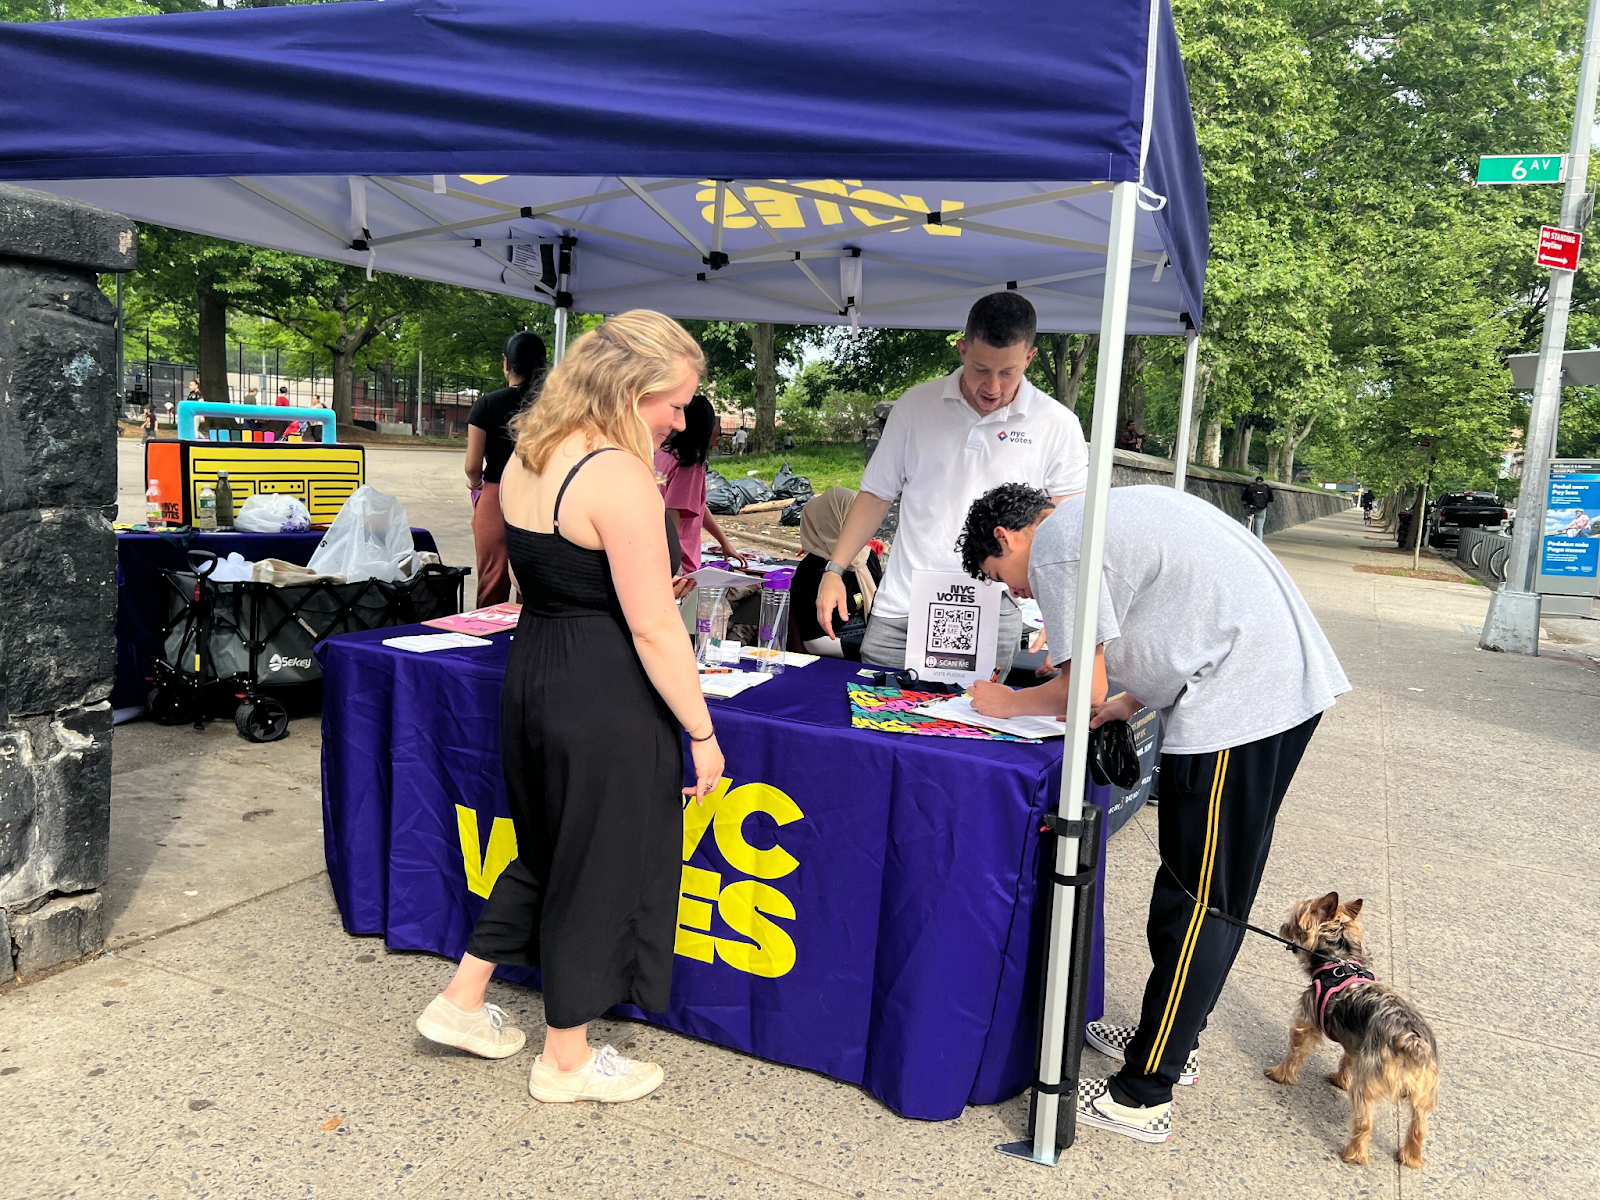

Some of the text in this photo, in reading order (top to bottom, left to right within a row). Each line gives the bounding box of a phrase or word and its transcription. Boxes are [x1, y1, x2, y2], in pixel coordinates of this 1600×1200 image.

[1511, 159, 1551, 180] 6 AV
[1542, 230, 1576, 244] NO STANDING
[1541, 240, 1562, 251] Anytime
[1010, 437, 1032, 445] votes
[950, 584, 976, 595] NYC
[937, 592, 976, 604] VOTES
[281, 655, 312, 669] Sekey
[938, 660, 970, 669] SCAN ME
[682, 777, 805, 880] YC
